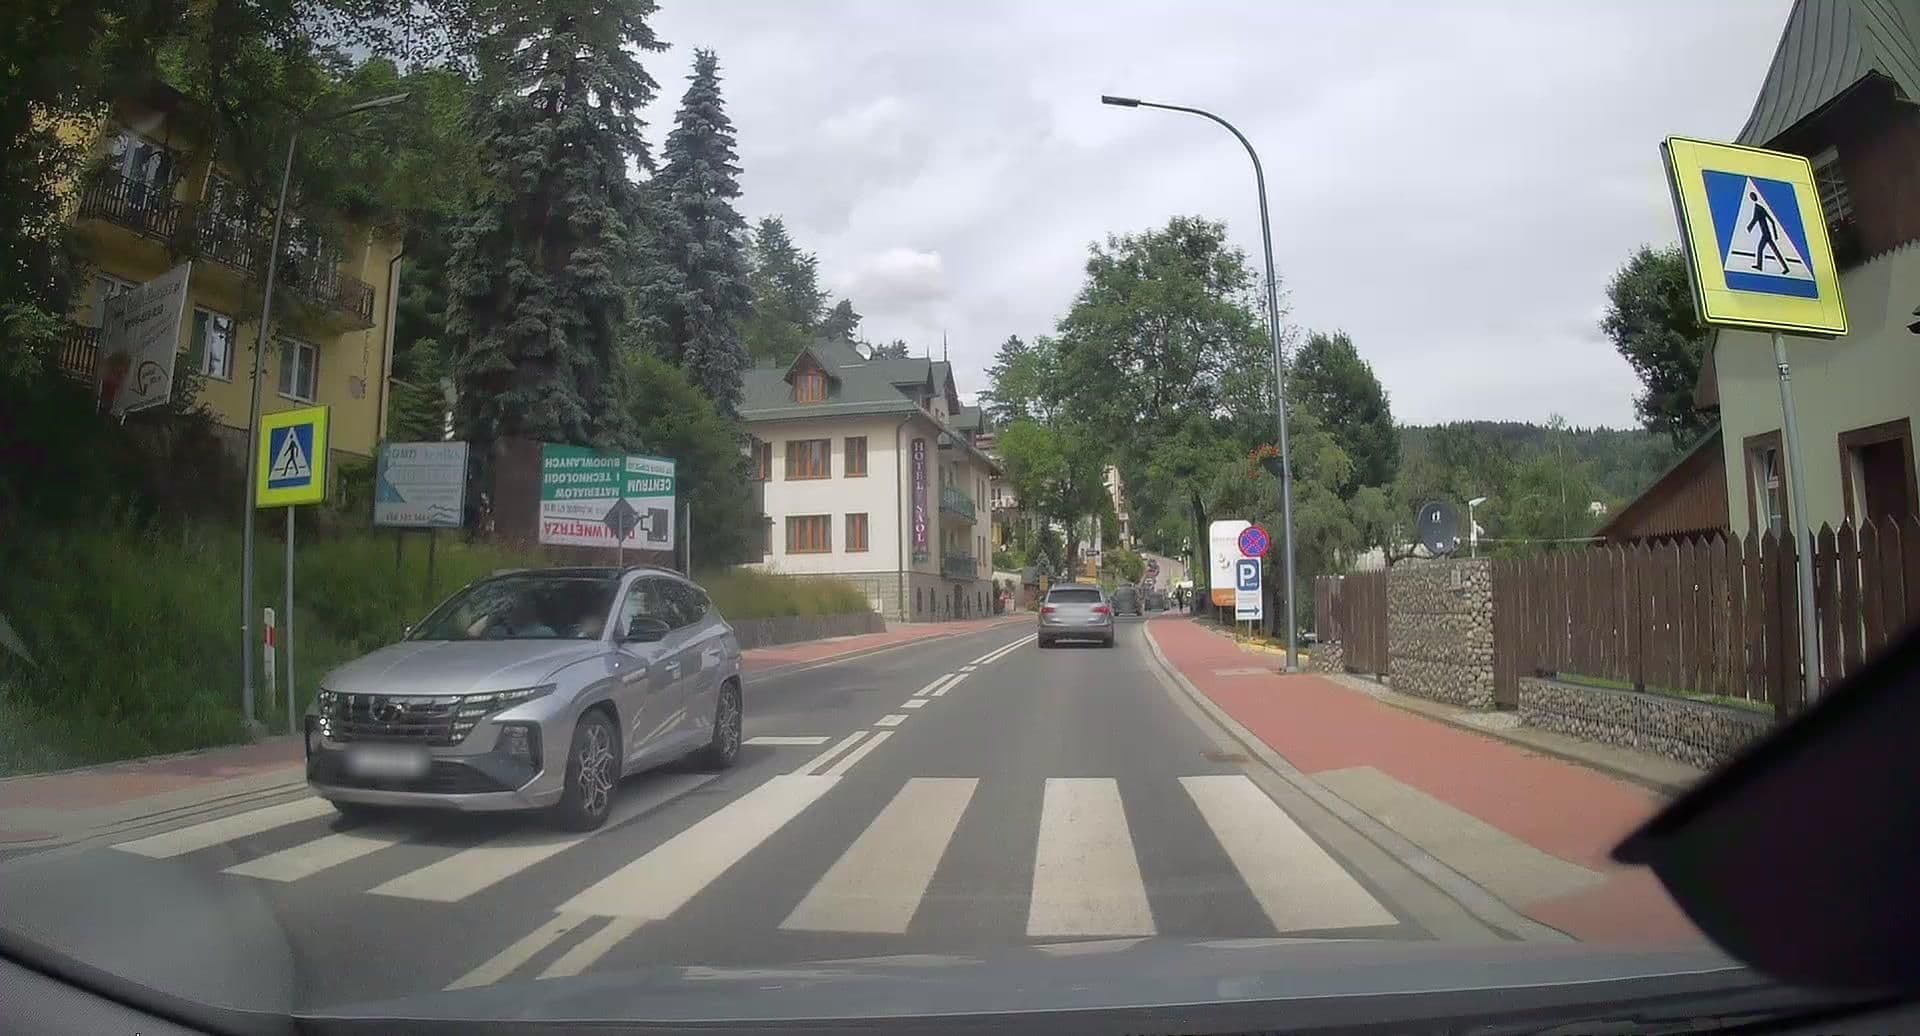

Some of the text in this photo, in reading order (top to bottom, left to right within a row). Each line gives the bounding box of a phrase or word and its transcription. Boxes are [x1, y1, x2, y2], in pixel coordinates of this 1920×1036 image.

[544, 457, 621, 468] BUDOWLANYCH
[915, 442, 923, 490] HOTEL
[544, 472, 611, 483] TECHNOLOGII
[627, 478, 672, 492] CENTRUM
[1239, 563, 1256, 587] P
